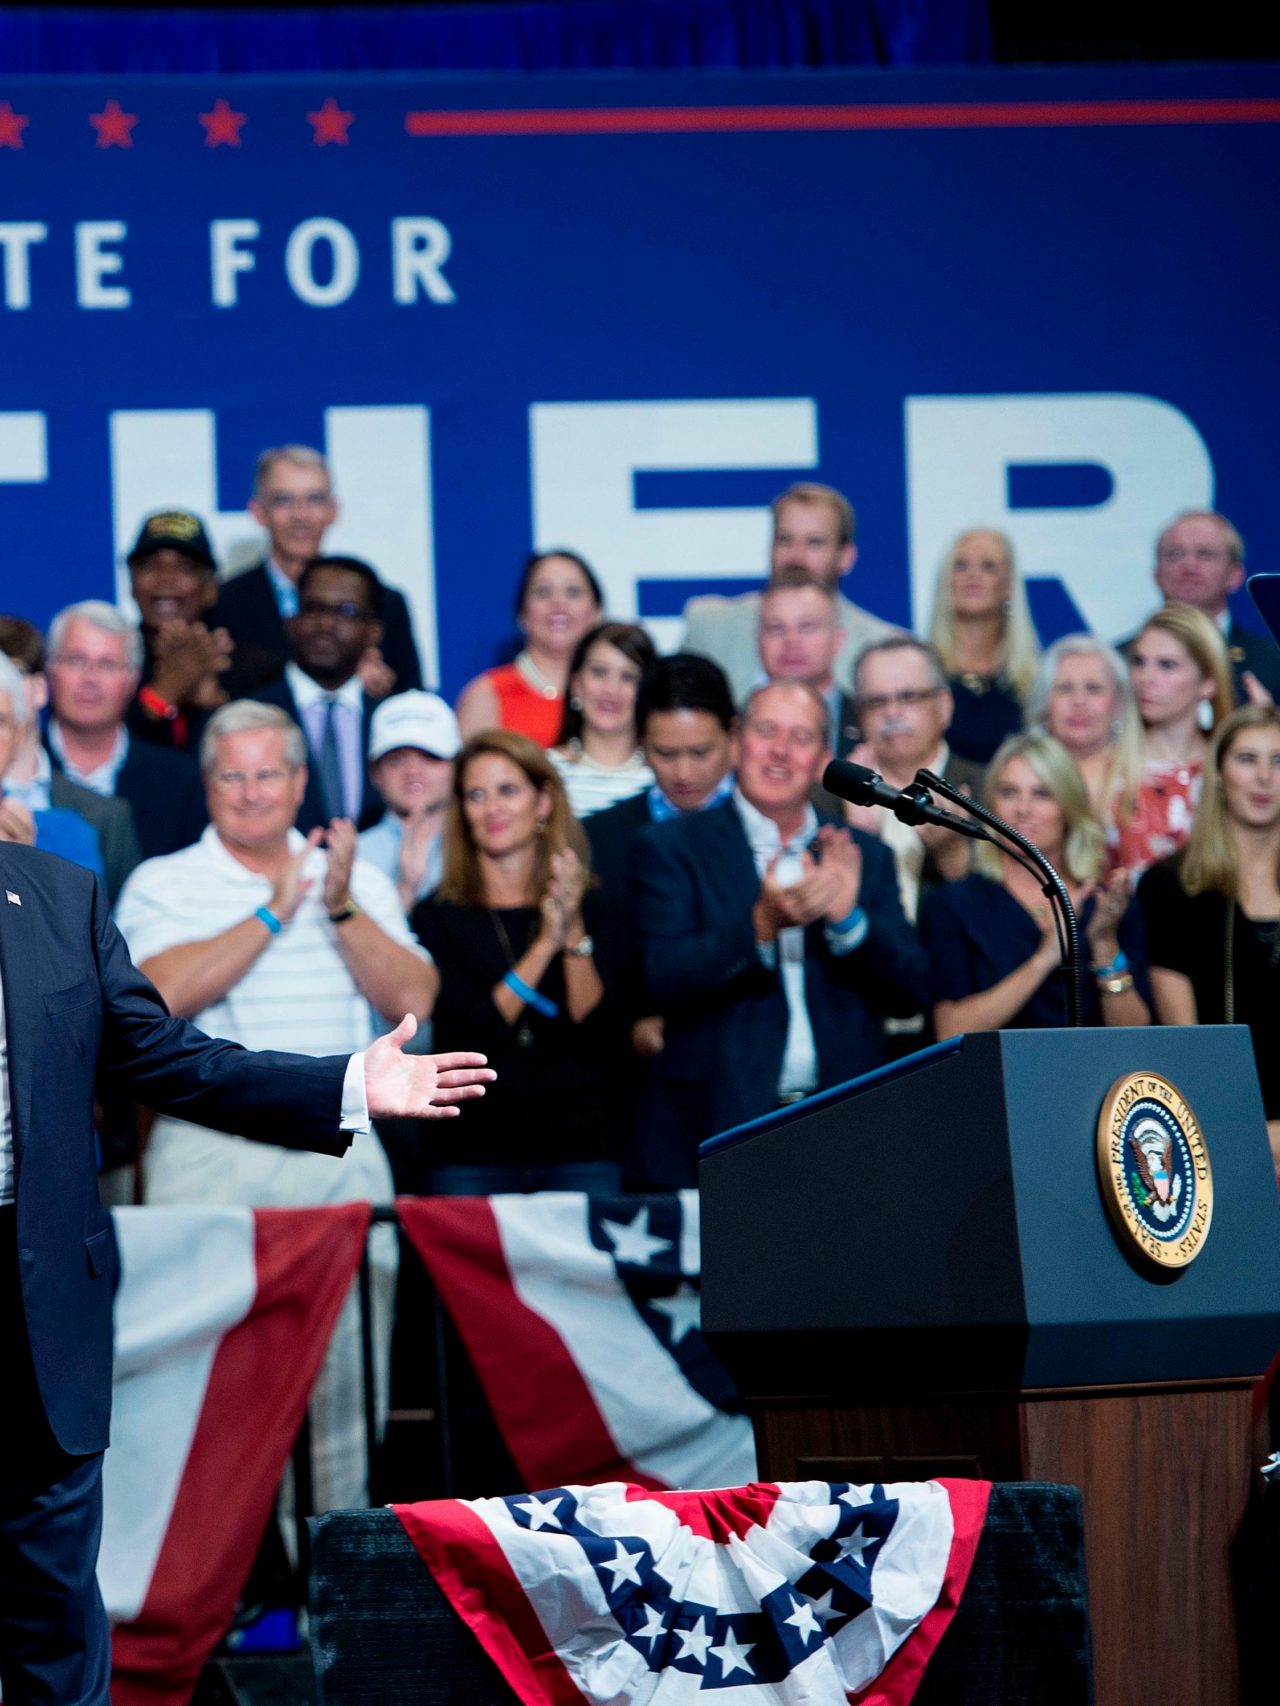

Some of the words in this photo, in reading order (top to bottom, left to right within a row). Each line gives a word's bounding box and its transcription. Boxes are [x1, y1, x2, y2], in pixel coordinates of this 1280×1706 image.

[209, 216, 457, 307] FOR
[1111, 1079, 1145, 1165] PRESIDENT
[1176, 1101, 1208, 1181] UNITED
[1134, 1218, 1163, 1258] SEAL
[1179, 1198, 1208, 1258] STATES
